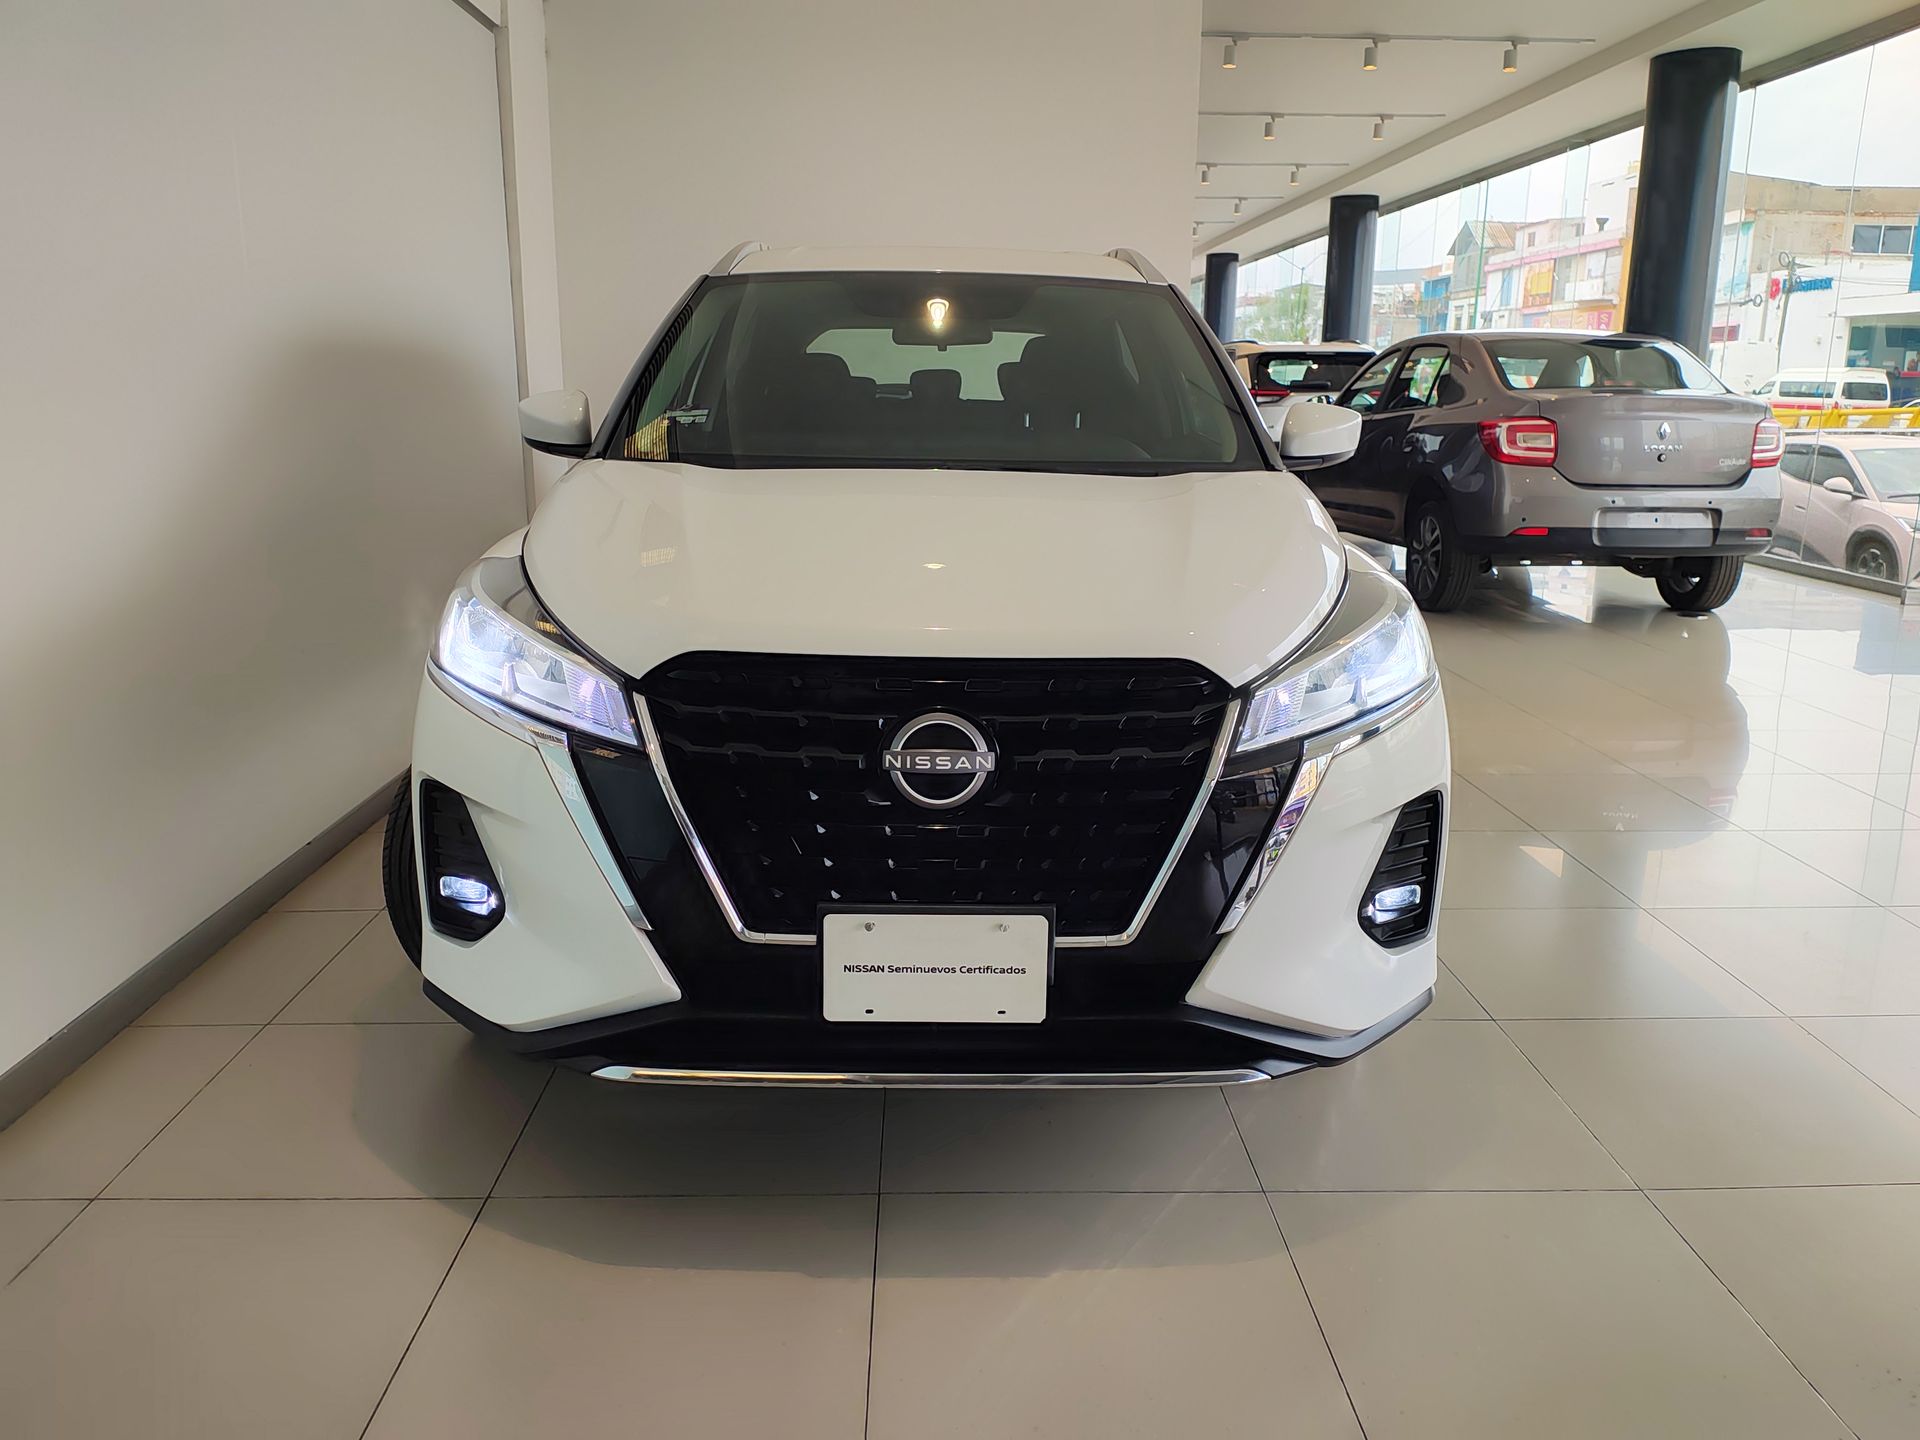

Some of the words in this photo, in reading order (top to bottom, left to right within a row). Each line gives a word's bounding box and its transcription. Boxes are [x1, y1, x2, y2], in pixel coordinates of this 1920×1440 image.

[1644, 444, 1683, 453] LOGAN
[885, 754, 992, 770] NISSAN
[843, 964, 885, 974] NISSAN
[887, 964, 957, 975] Seminuevos
[959, 965, 1027, 975] Certificados
